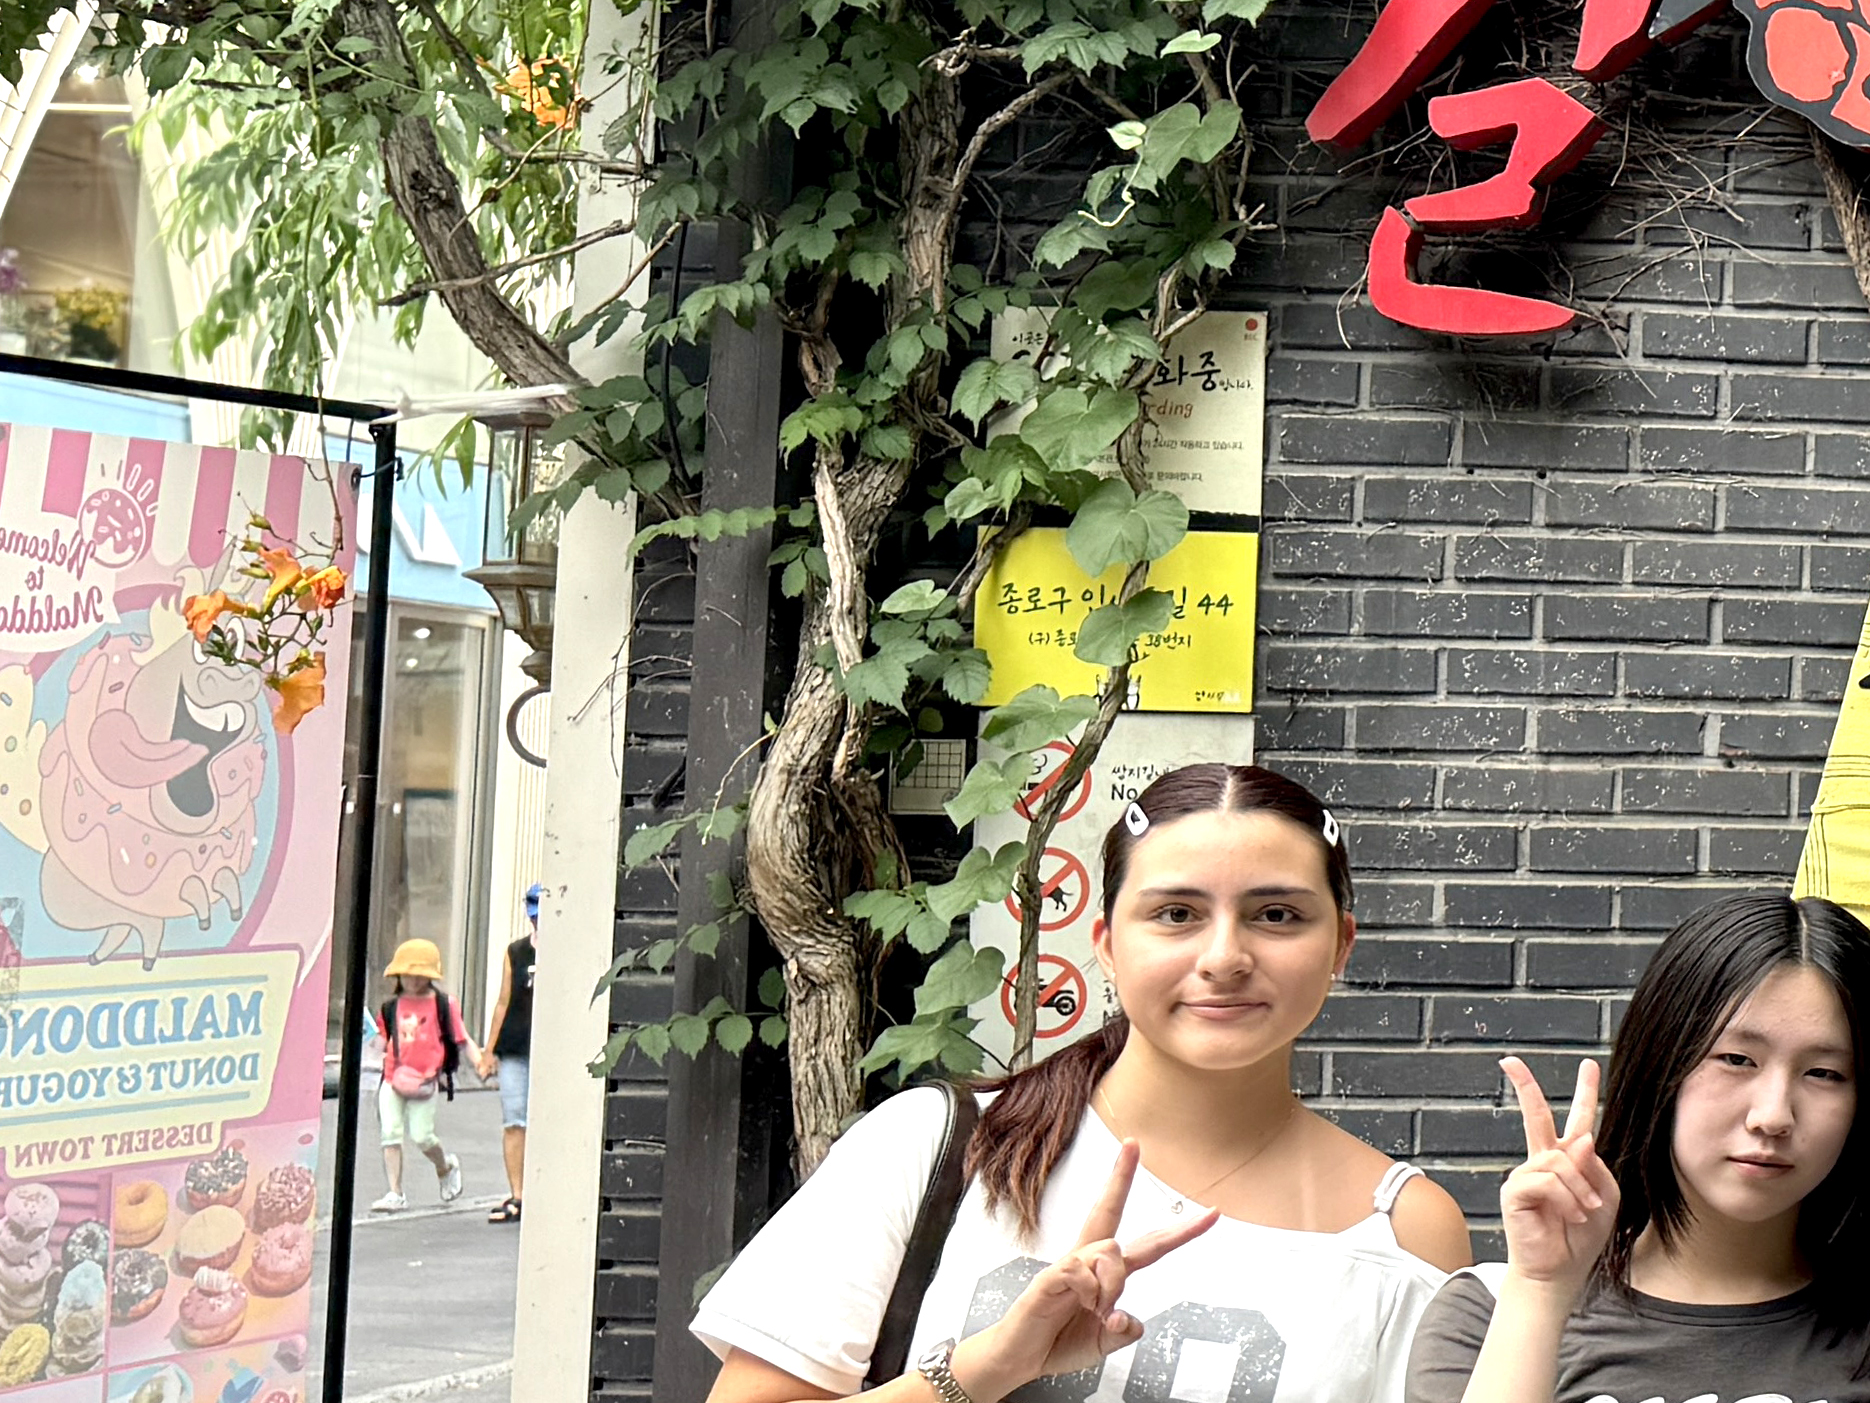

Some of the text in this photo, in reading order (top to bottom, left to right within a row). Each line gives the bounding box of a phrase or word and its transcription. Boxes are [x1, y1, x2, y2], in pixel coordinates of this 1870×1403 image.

[998, 583, 1072, 615] 종로구
[1197, 593, 1234, 616] 44
[1111, 783, 1138, 800] No
